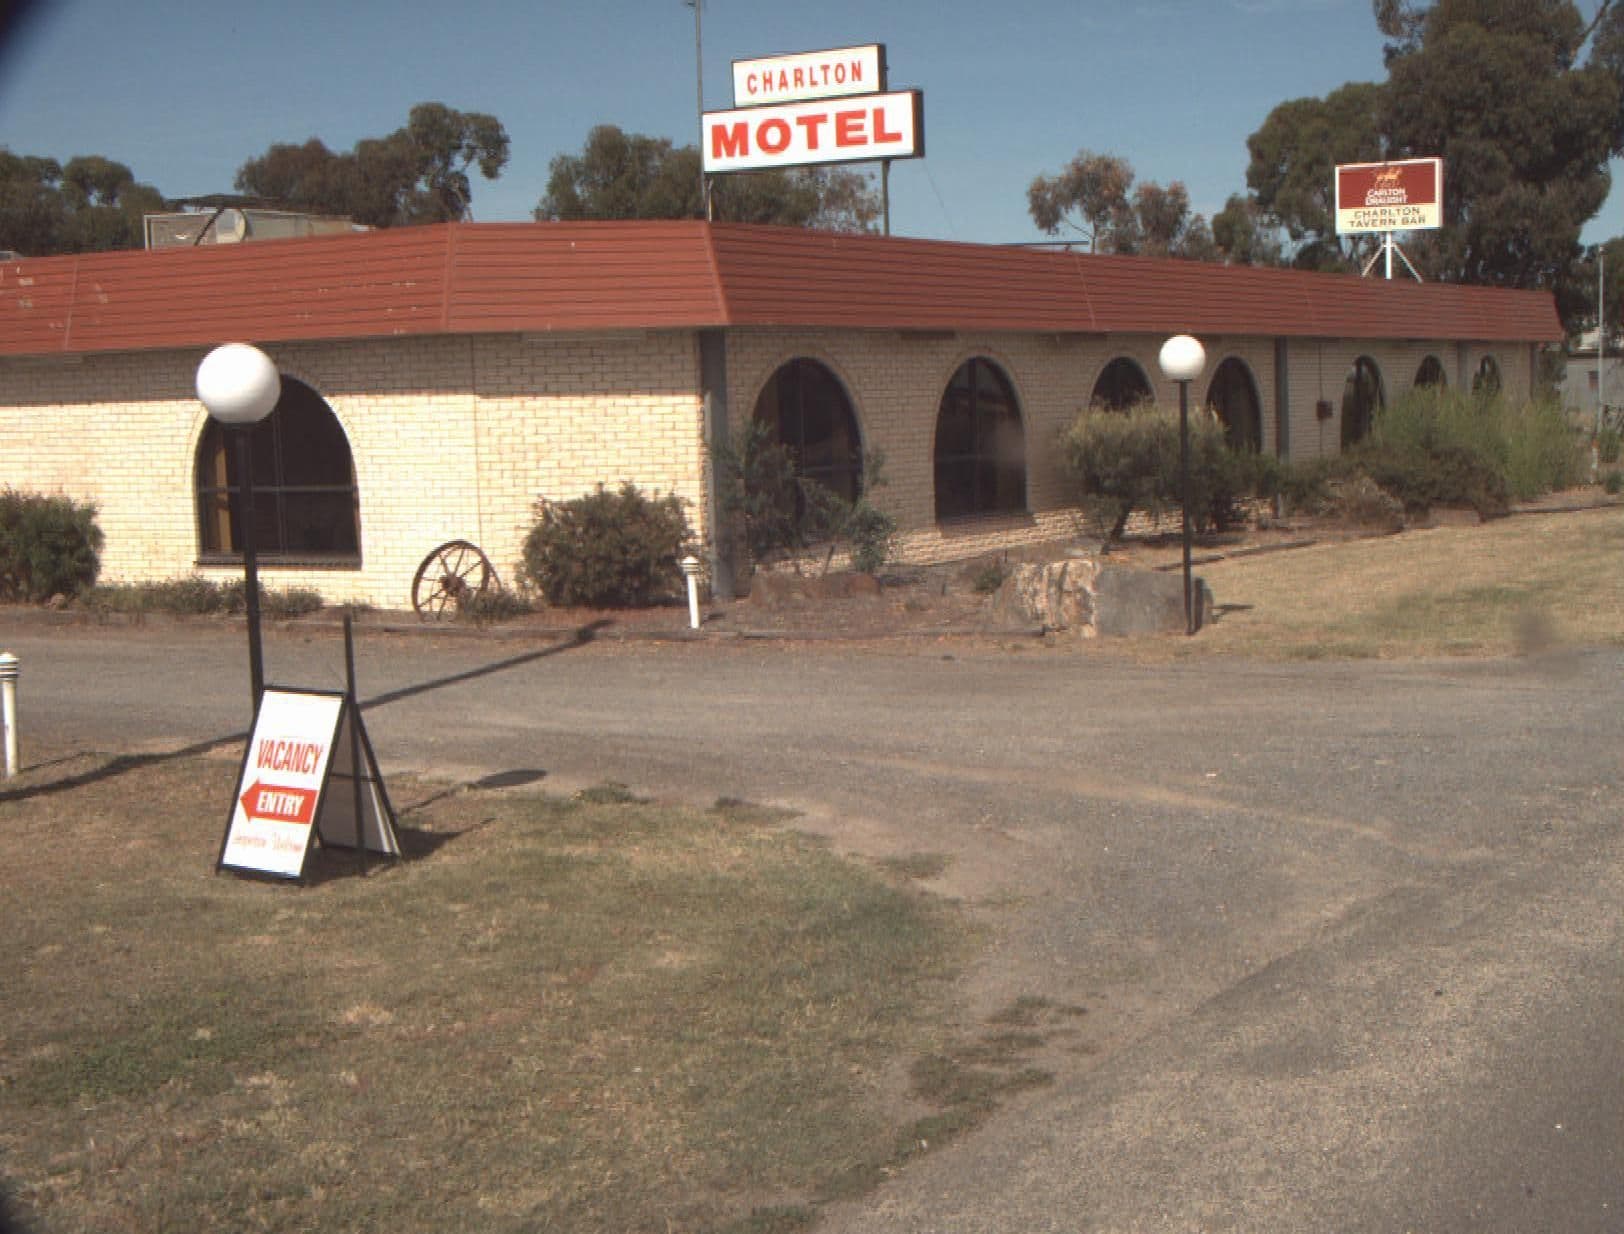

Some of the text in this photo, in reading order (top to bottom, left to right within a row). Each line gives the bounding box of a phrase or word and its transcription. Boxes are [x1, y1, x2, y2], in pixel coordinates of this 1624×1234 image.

[746, 60, 863, 95] CHARLTON
[711, 107, 903, 160] MOTEL
[1367, 188, 1406, 197] CARLTON
[1348, 216, 1426, 228] TAVERN BAR
[1354, 206, 1420, 219] CHARLTON
[257, 738, 323, 775] VACANCY
[256, 791, 304, 817] ENTRY
